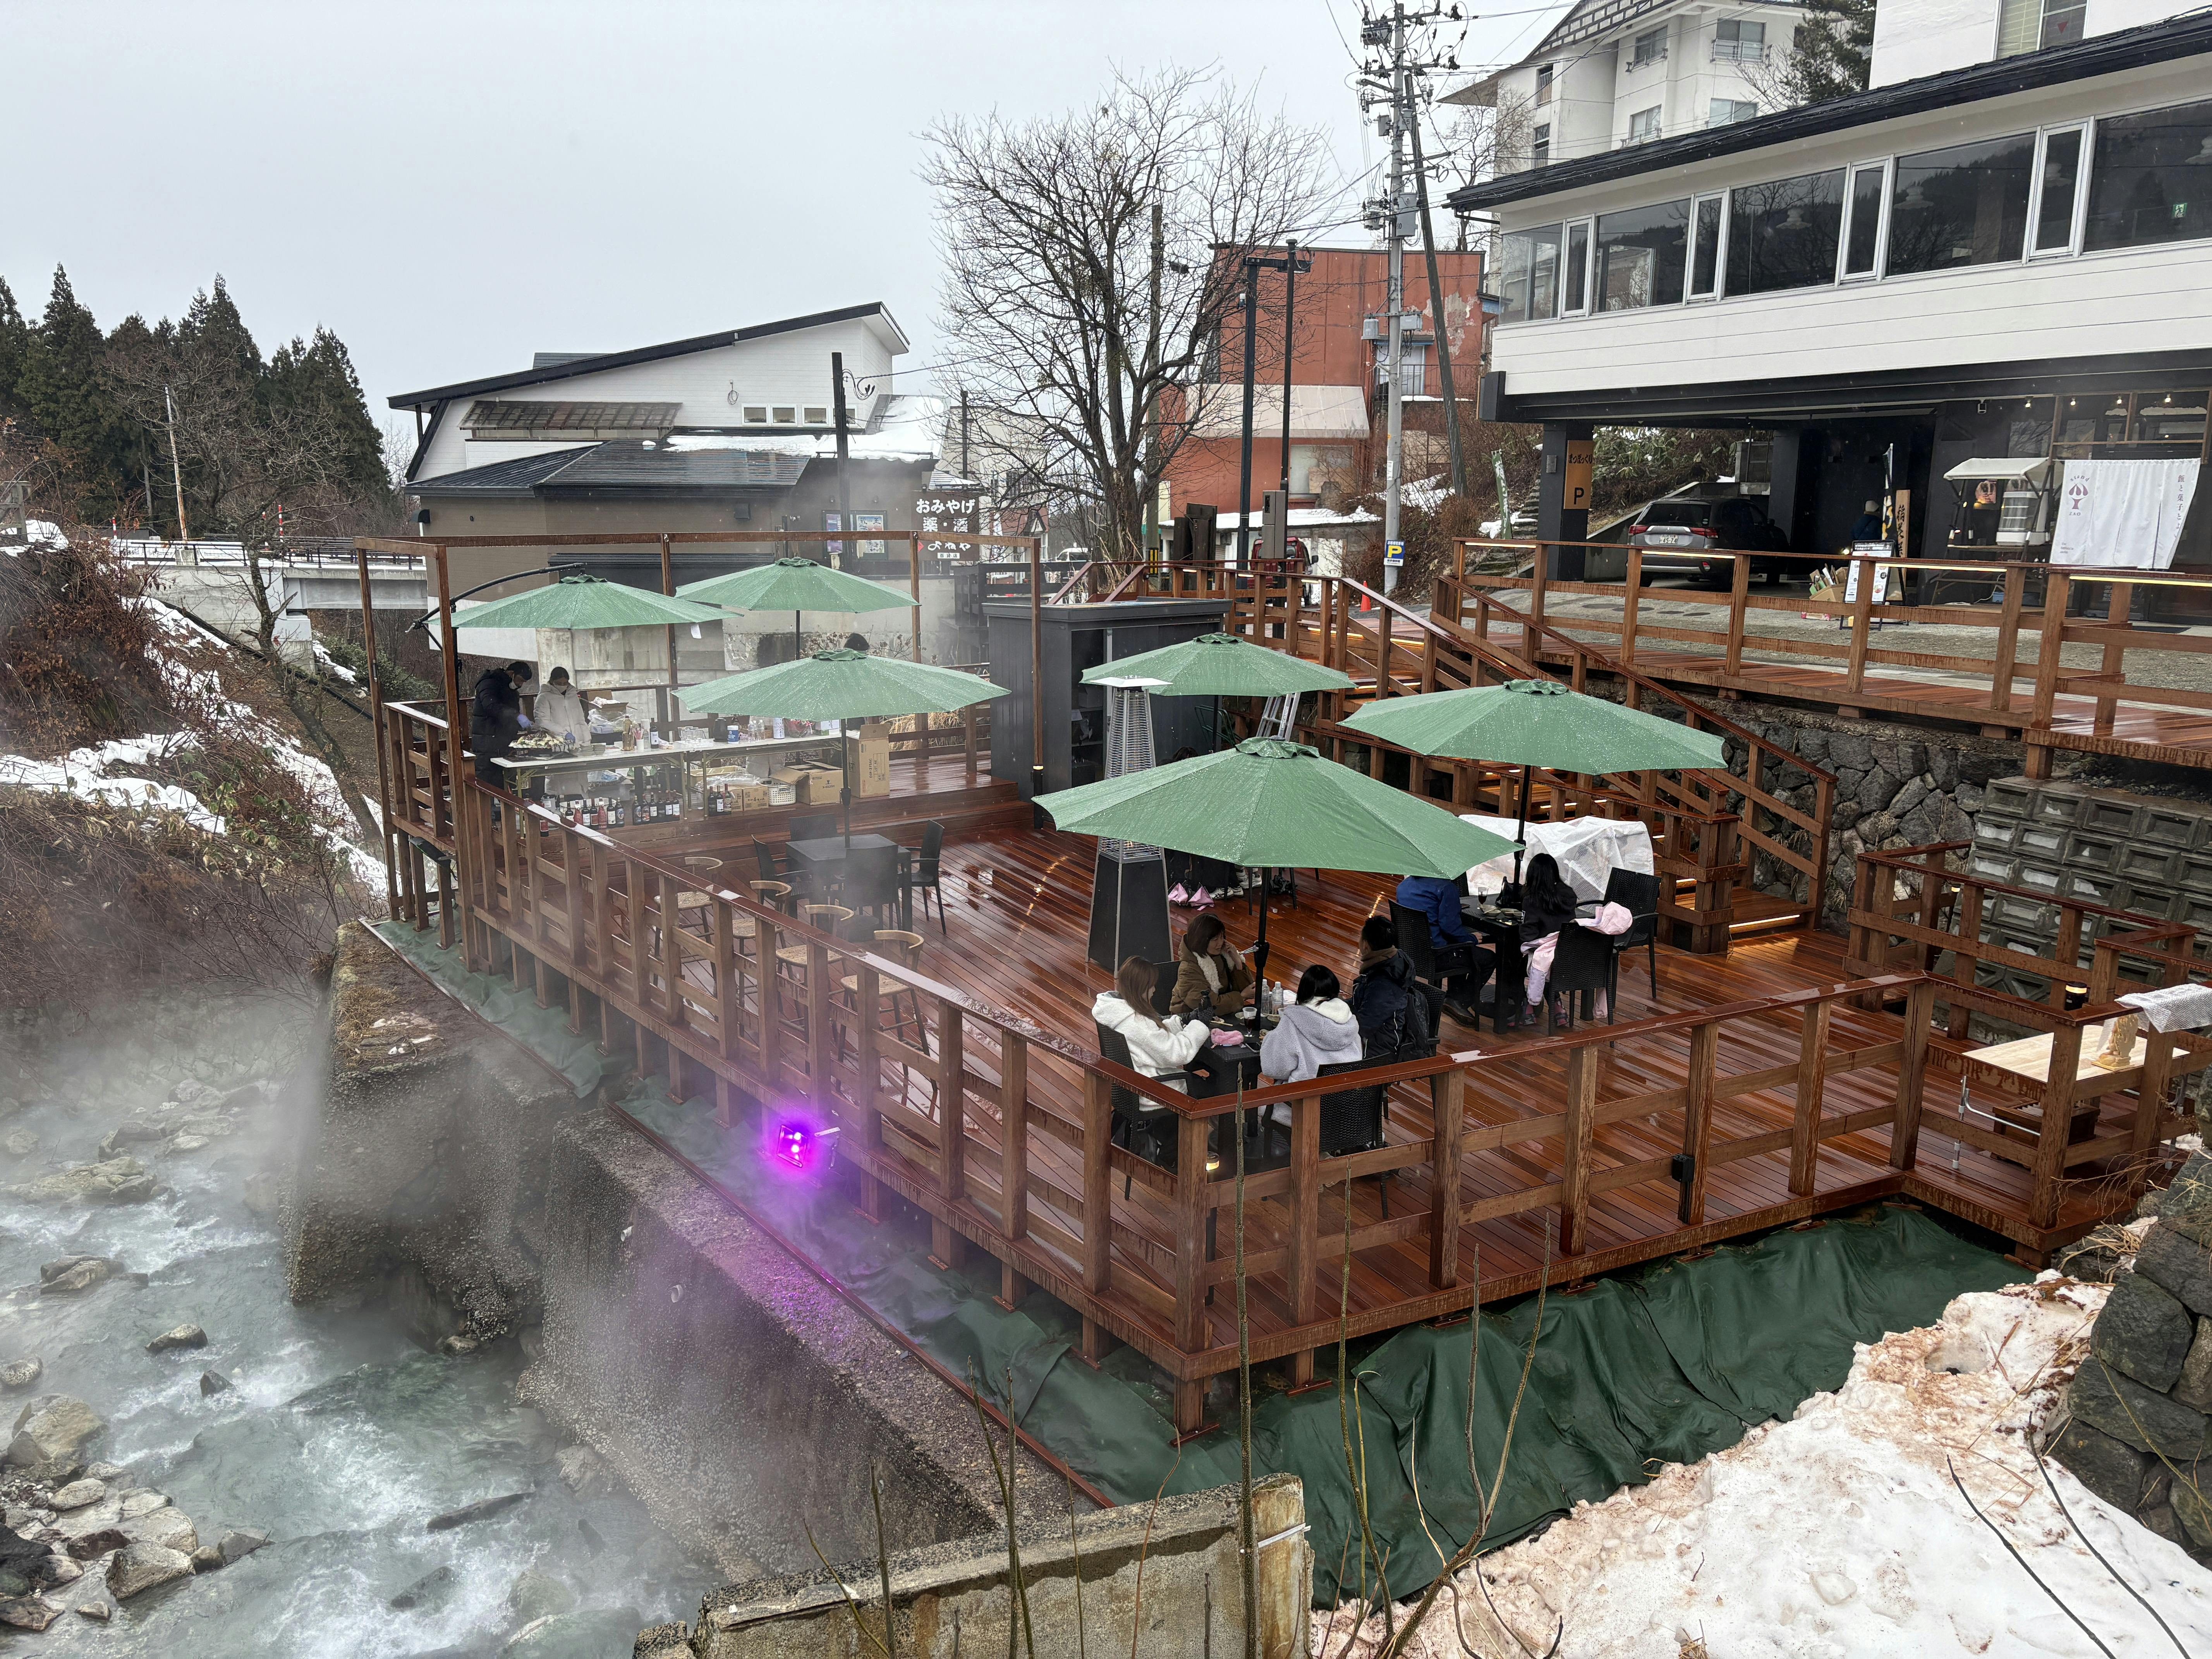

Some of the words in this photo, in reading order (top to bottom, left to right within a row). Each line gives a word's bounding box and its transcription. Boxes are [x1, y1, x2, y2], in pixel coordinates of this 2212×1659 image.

[1574, 487, 1584, 505] P
[916, 498, 975, 514] おみやげ
[1388, 545, 1402, 558] P
